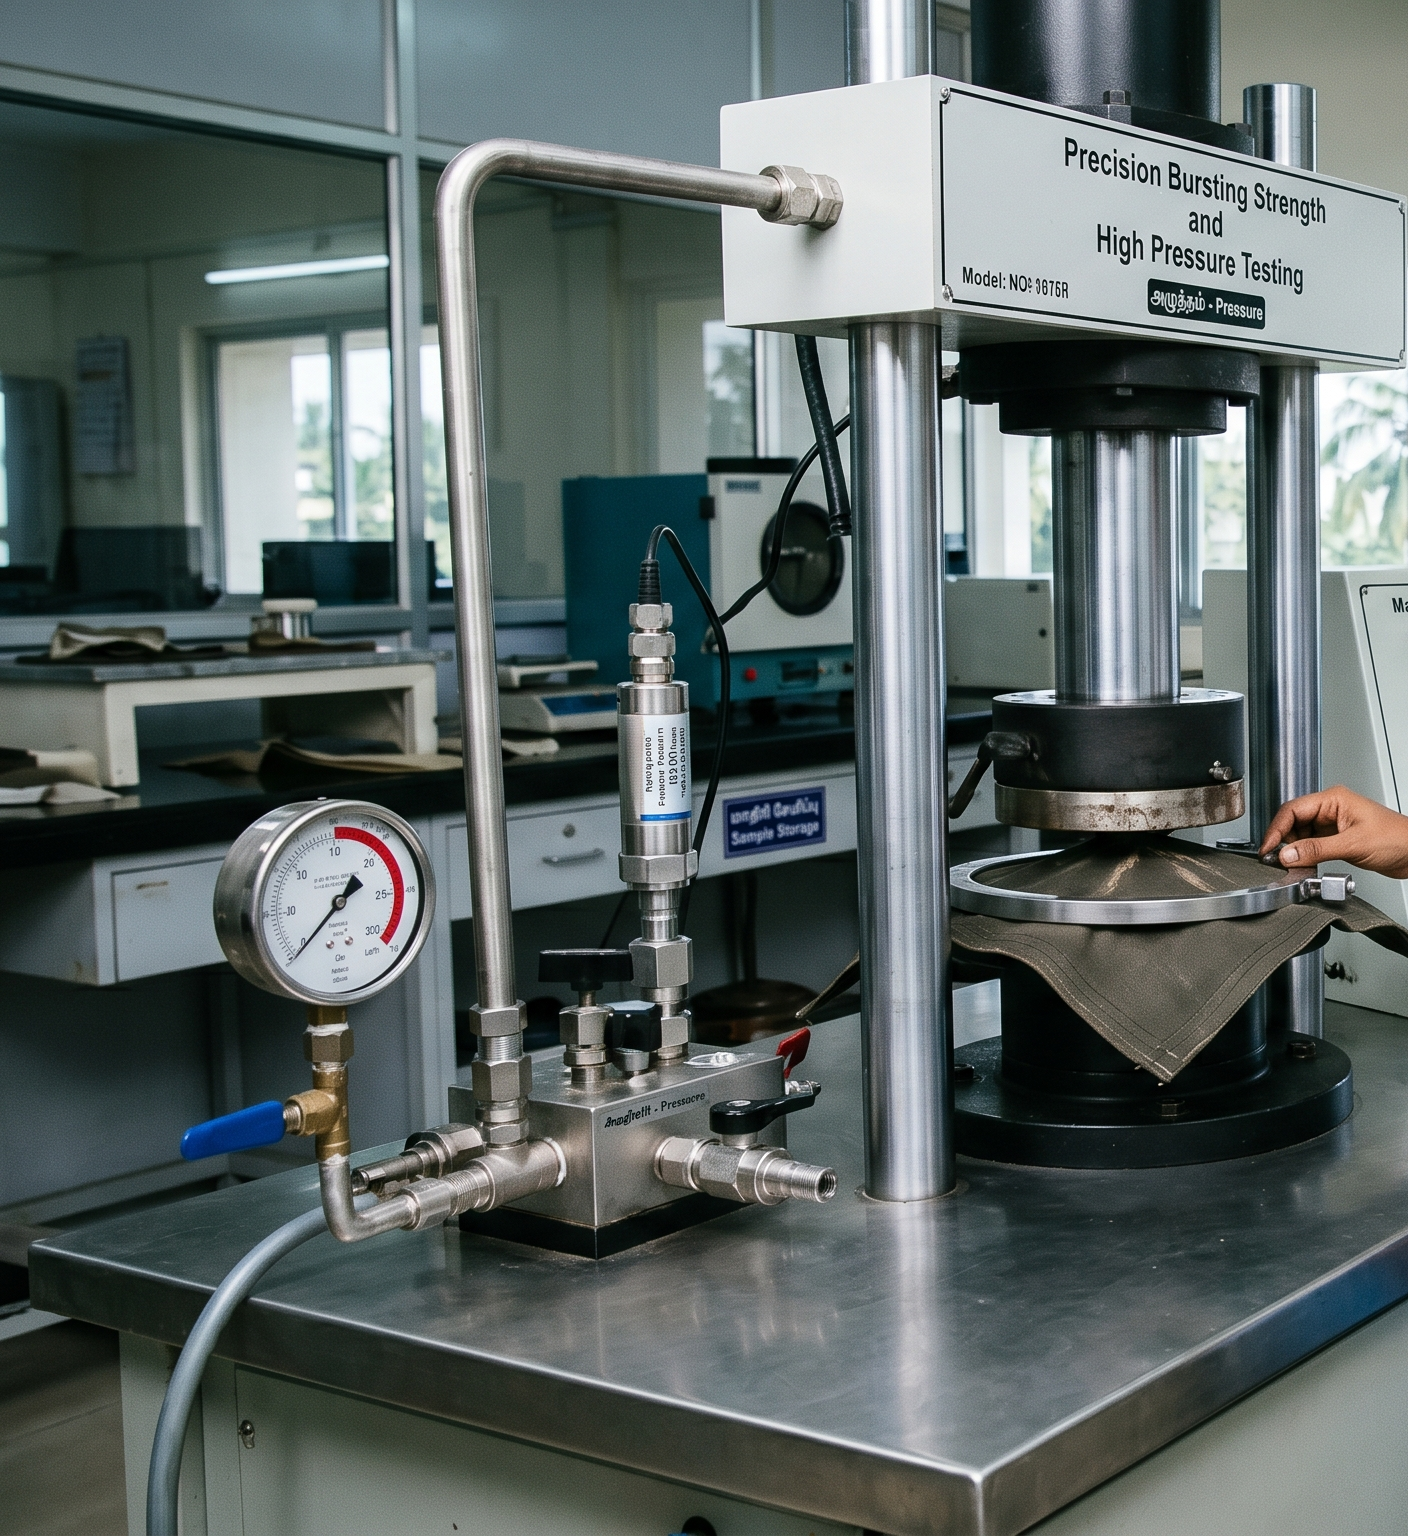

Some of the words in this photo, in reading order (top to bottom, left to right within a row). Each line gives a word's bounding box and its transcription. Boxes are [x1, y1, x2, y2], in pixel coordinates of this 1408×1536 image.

[1064, 136, 1161, 187] Precision
[1168, 161, 1248, 213] Bursting
[1254, 182, 1326, 227] Strength
[1188, 210, 1223, 238] and
[1096, 223, 1144, 266] High
[1151, 234, 1236, 277] Pressure
[1241, 251, 1304, 295] Testing
[962, 266, 1006, 290] Model:
[1215, 297, 1264, 321] Pressure
[731, 826, 775, 846] Sample
[776, 821, 819, 838] Storage
[329, 846, 341, 857] 10
[375, 889, 388, 900] 25
[365, 924, 381, 936] 300
